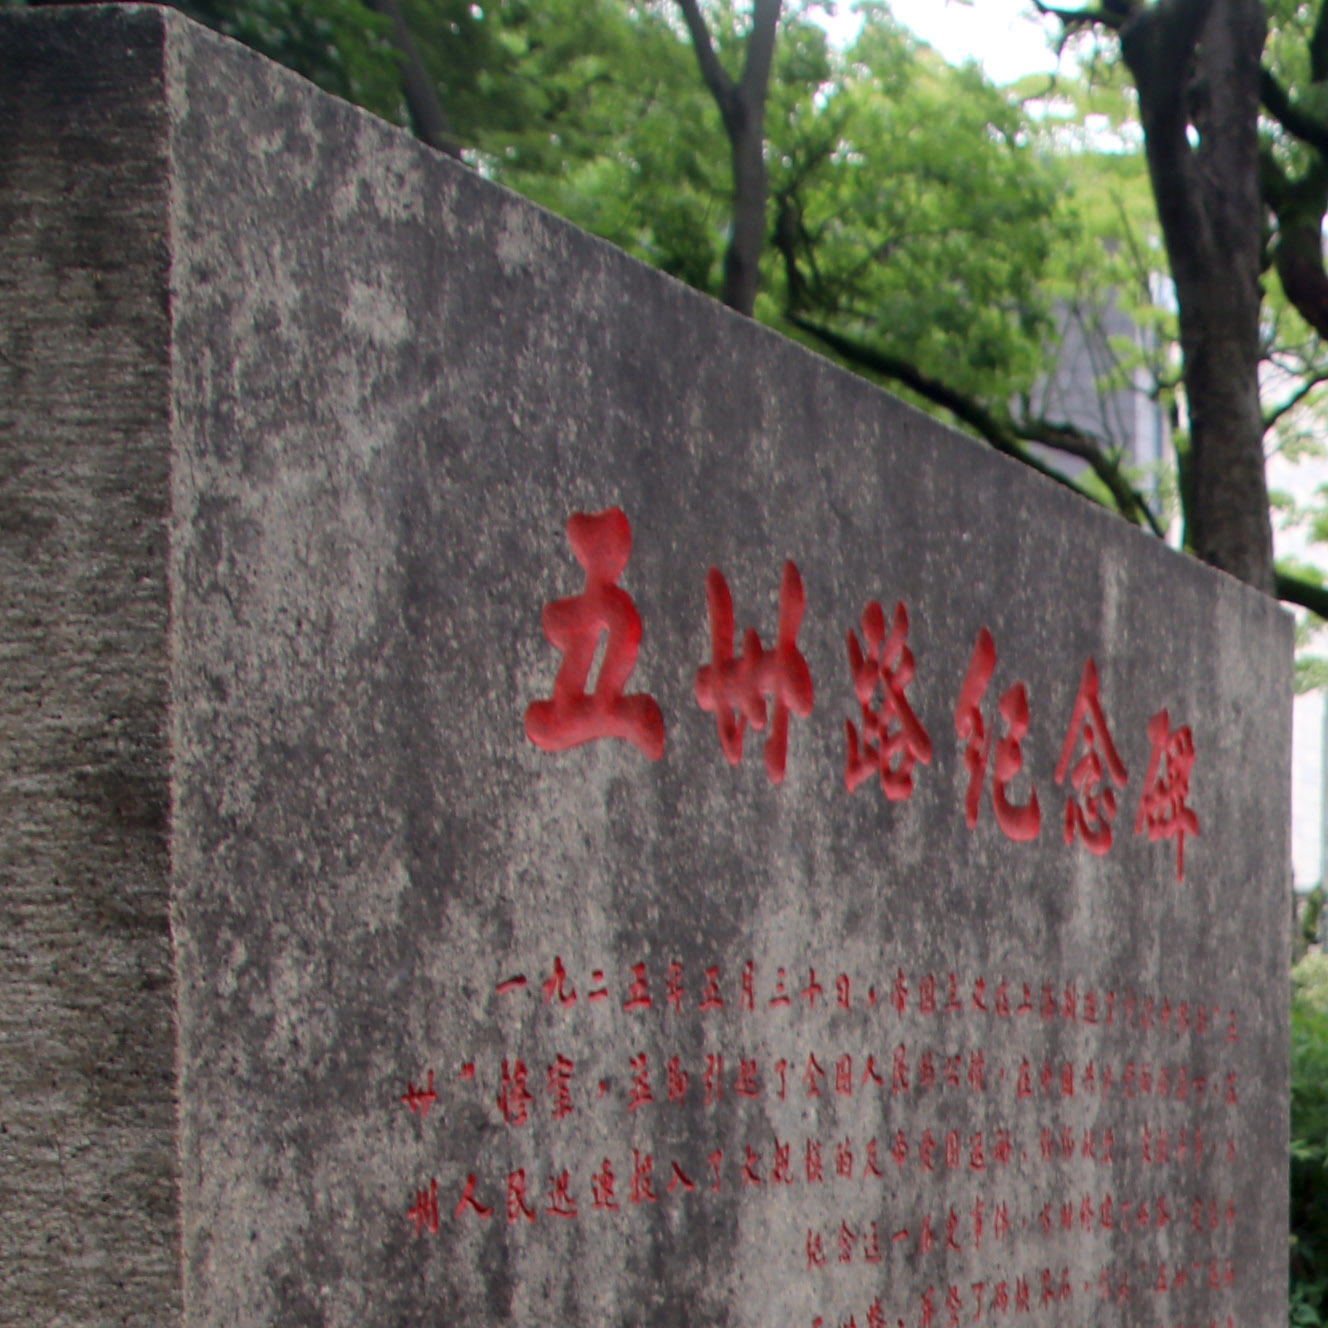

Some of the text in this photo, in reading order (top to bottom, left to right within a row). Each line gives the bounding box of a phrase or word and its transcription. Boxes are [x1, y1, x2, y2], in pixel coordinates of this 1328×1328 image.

[525, 506, 1199, 883] 五卅路纪念碑
